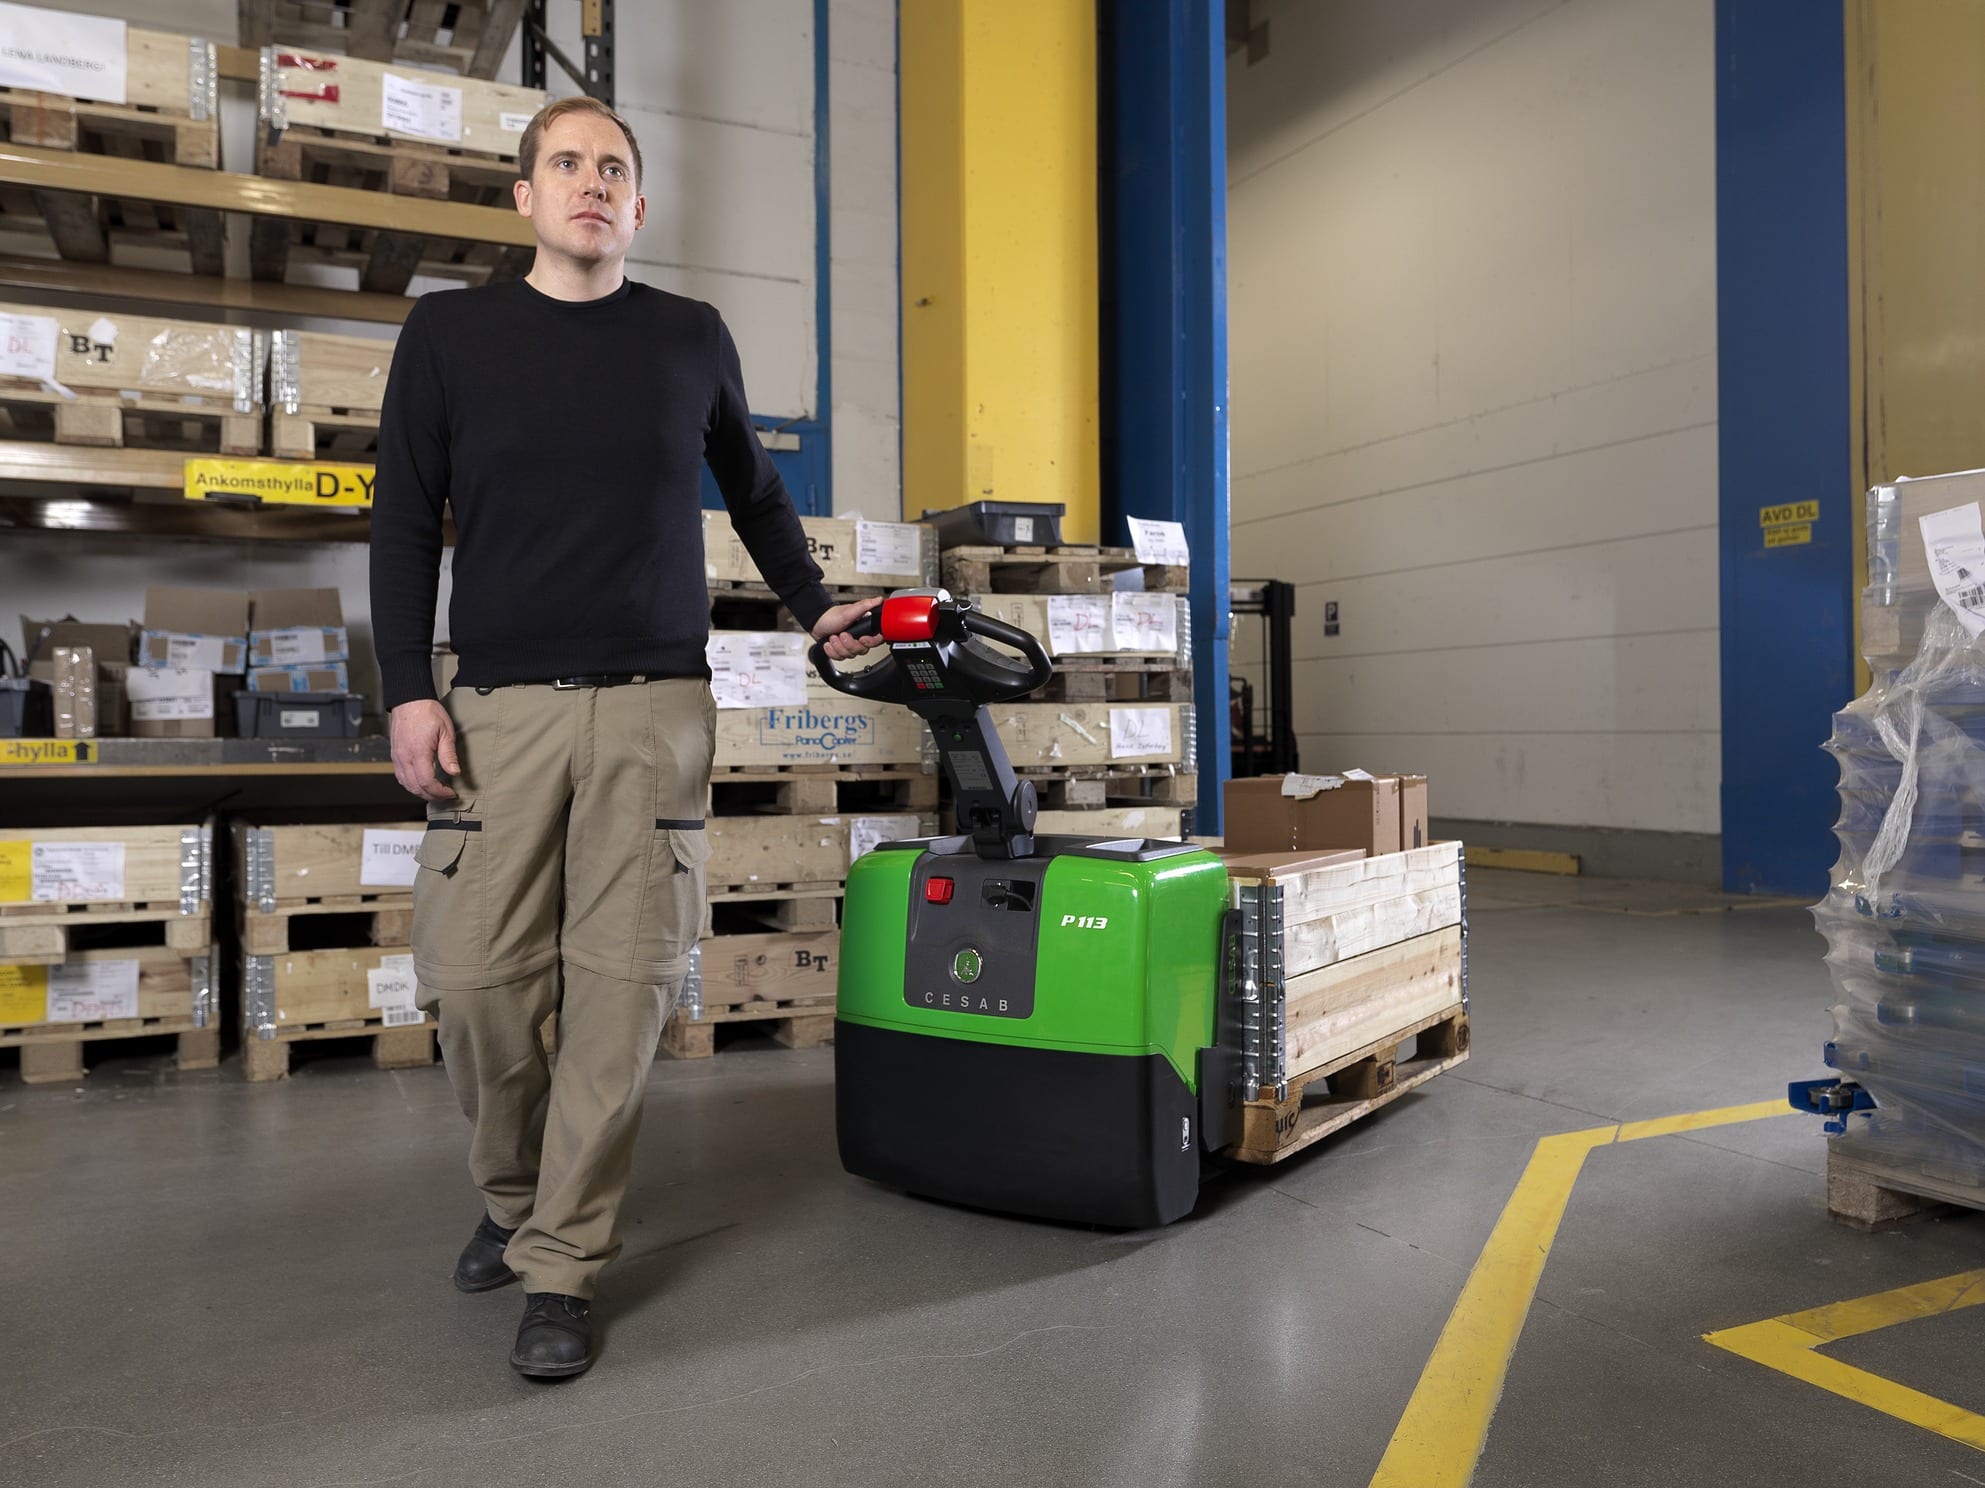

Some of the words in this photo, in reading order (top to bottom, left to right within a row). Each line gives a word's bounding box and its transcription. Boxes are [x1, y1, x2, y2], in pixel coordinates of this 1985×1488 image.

[70, 335, 114, 362] BT
[196, 473, 313, 493] Ankomsthylla
[1762, 506, 1793, 525] AVD
[1796, 503, 1817, 520] DL
[769, 709, 868, 735] Fribergs
[795, 950, 828, 971] BT
[1227, 933, 1236, 995] CESAB
[924, 991, 1009, 1012] CESAB
